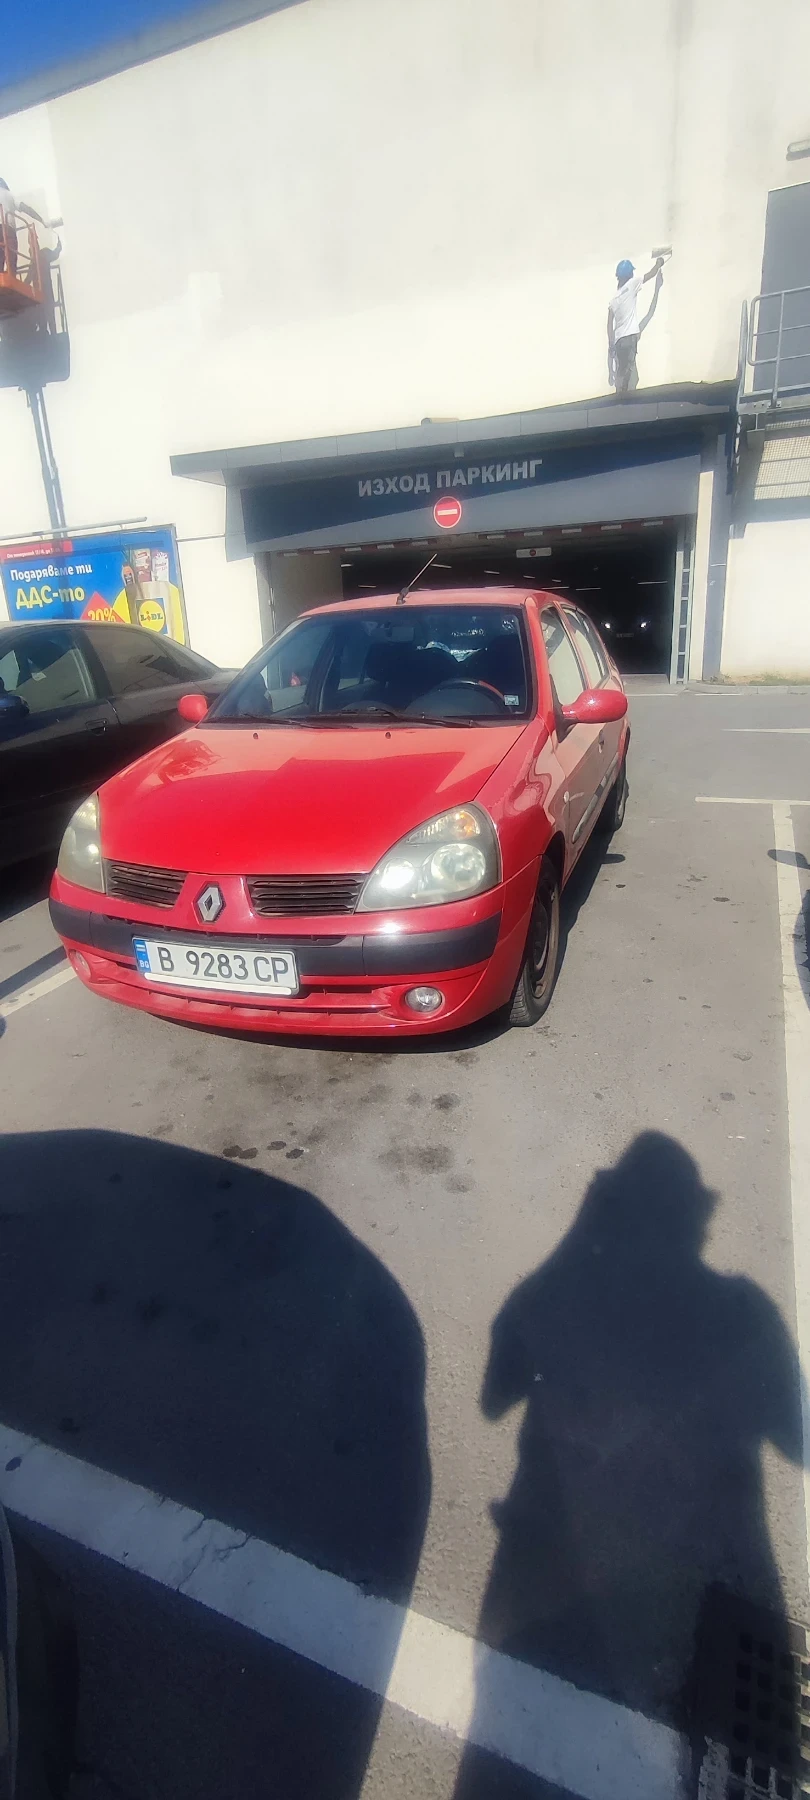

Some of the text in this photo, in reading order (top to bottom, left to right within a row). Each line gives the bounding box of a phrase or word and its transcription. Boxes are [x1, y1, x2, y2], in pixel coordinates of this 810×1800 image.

[358, 459, 543, 497] ИЗХОД ПАРКИНГ
[10, 564, 92, 582] Подаряваме ти
[15, 585, 85, 610] ДДС-то
[139, 960, 150, 969] BG
[157, 947, 289, 983] B 9283 CP
